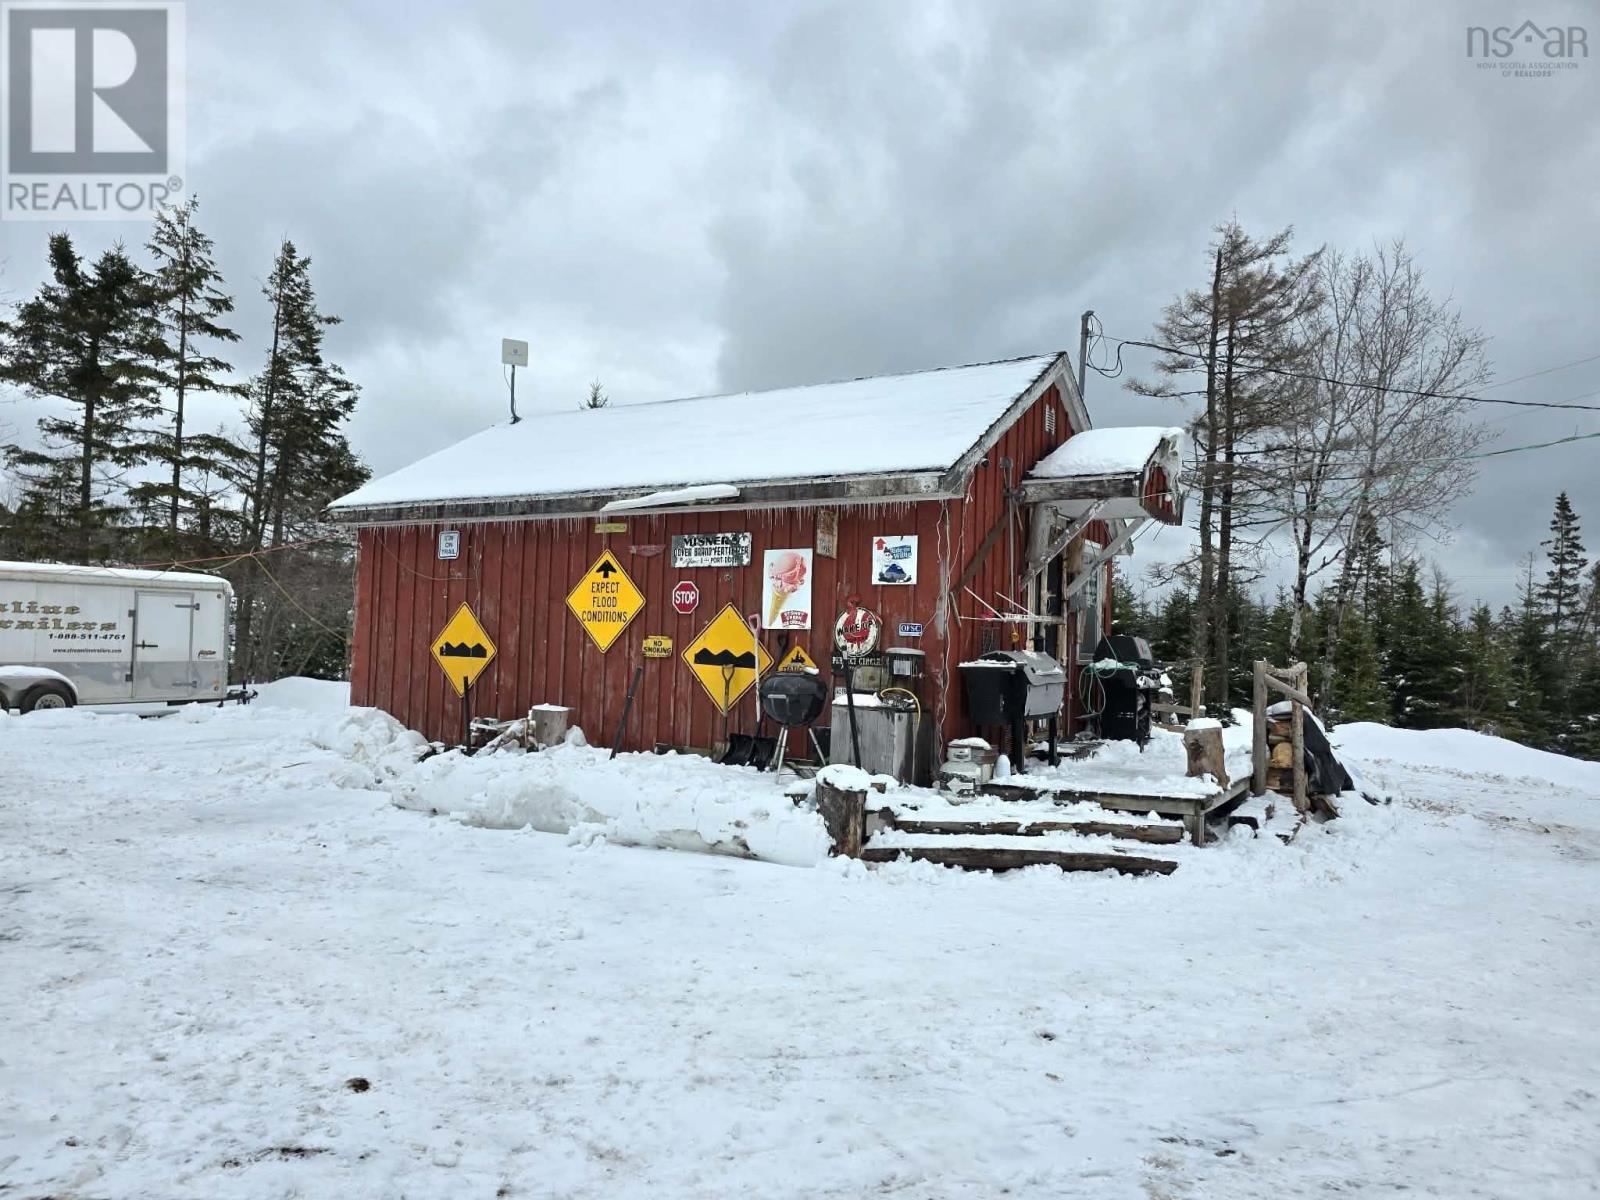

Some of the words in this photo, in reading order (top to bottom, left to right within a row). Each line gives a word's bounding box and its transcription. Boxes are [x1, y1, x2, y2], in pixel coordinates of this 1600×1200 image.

[591, 581, 620, 593] EXPECT
[592, 596, 617, 608] FLOOD
[675, 590, 696, 604] STOP
[581, 610, 628, 623] CONDITIONS
[837, 623, 860, 637] WAKE
